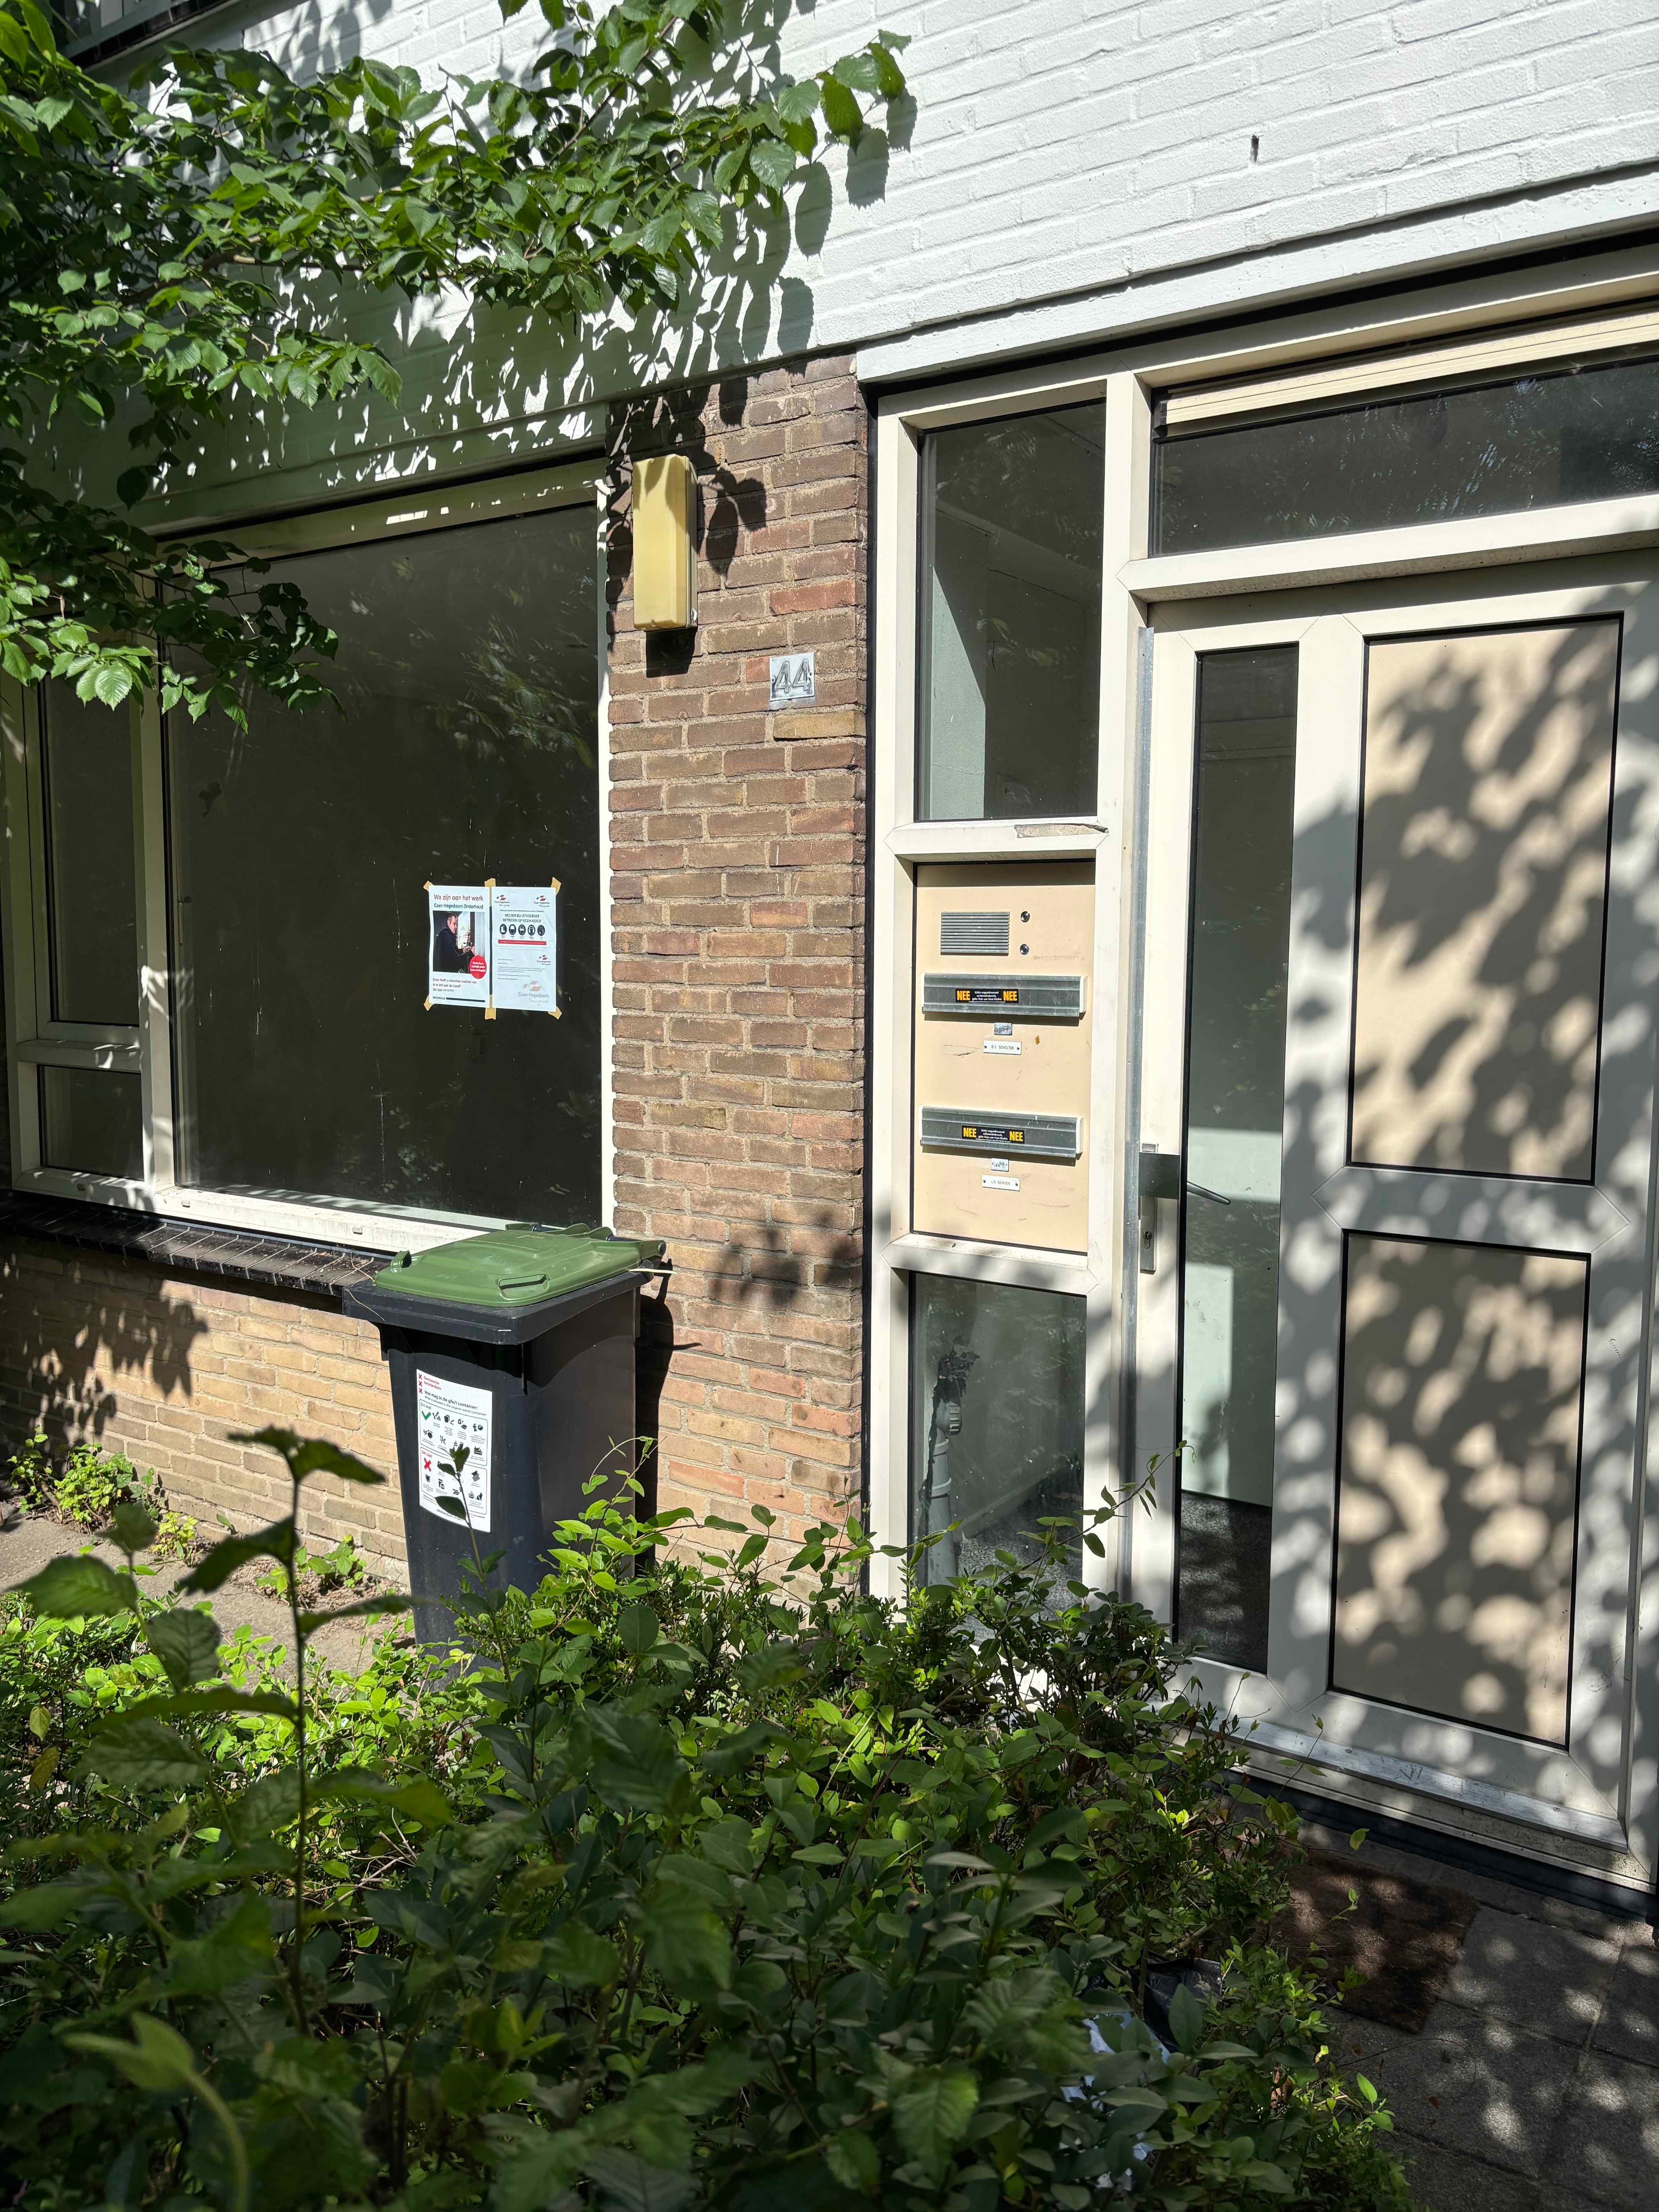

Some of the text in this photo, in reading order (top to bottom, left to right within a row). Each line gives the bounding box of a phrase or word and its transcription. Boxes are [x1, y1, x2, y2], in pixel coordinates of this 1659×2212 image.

[774, 658, 810, 694] 44
[957, 991, 1017, 1001] NEE NEE
[963, 1127, 977, 1138] NEE
[1009, 1131, 1023, 1142] NEE
[458, 1402, 478, 1410] container:
